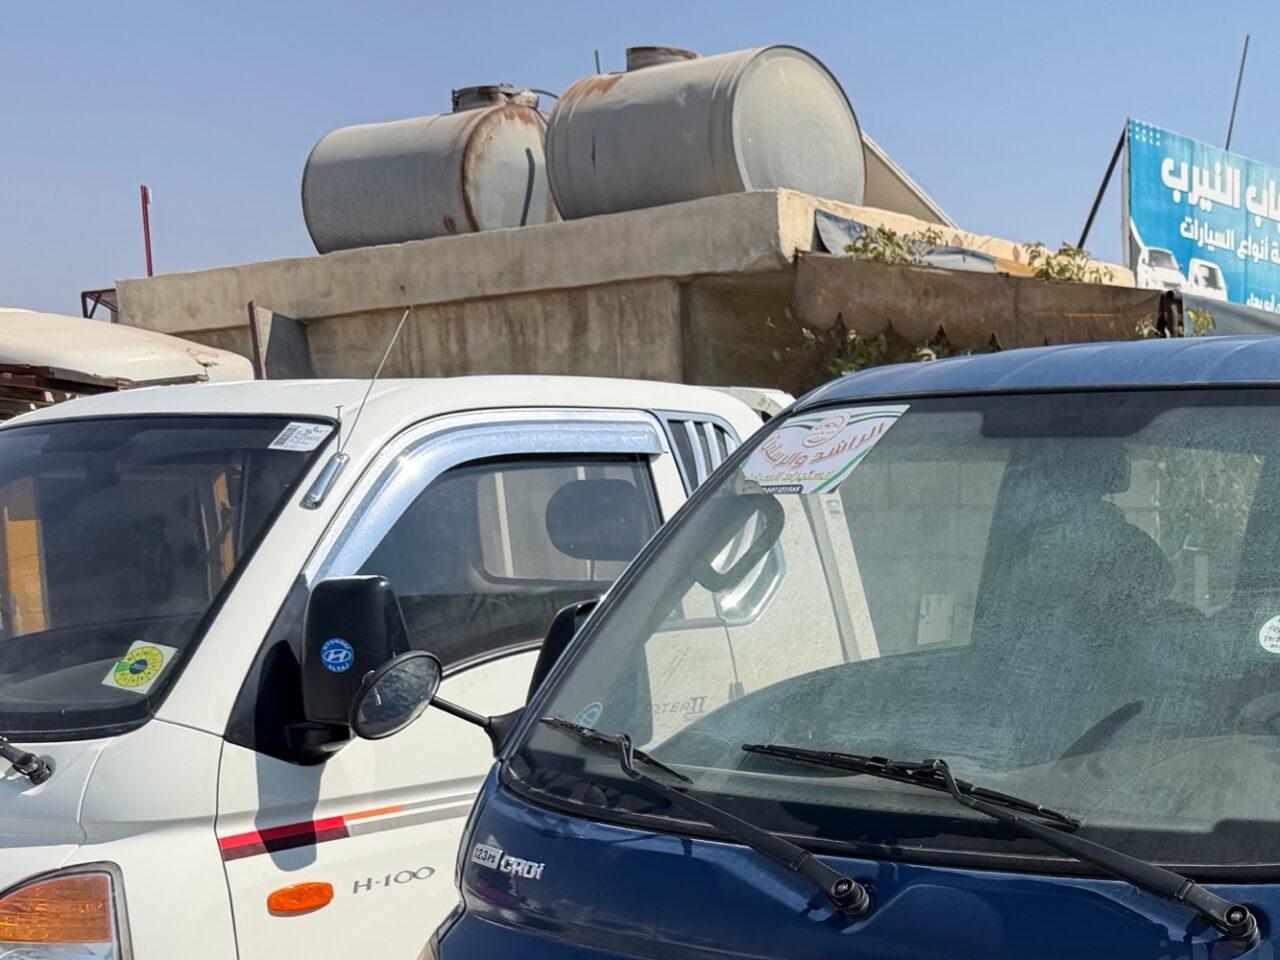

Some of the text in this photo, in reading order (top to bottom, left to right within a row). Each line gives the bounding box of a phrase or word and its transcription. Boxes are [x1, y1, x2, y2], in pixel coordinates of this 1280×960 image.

[1161, 158, 1241, 212] النيرب
[1179, 216, 1235, 251] السيارات
[352, 866, 435, 895] H-100
